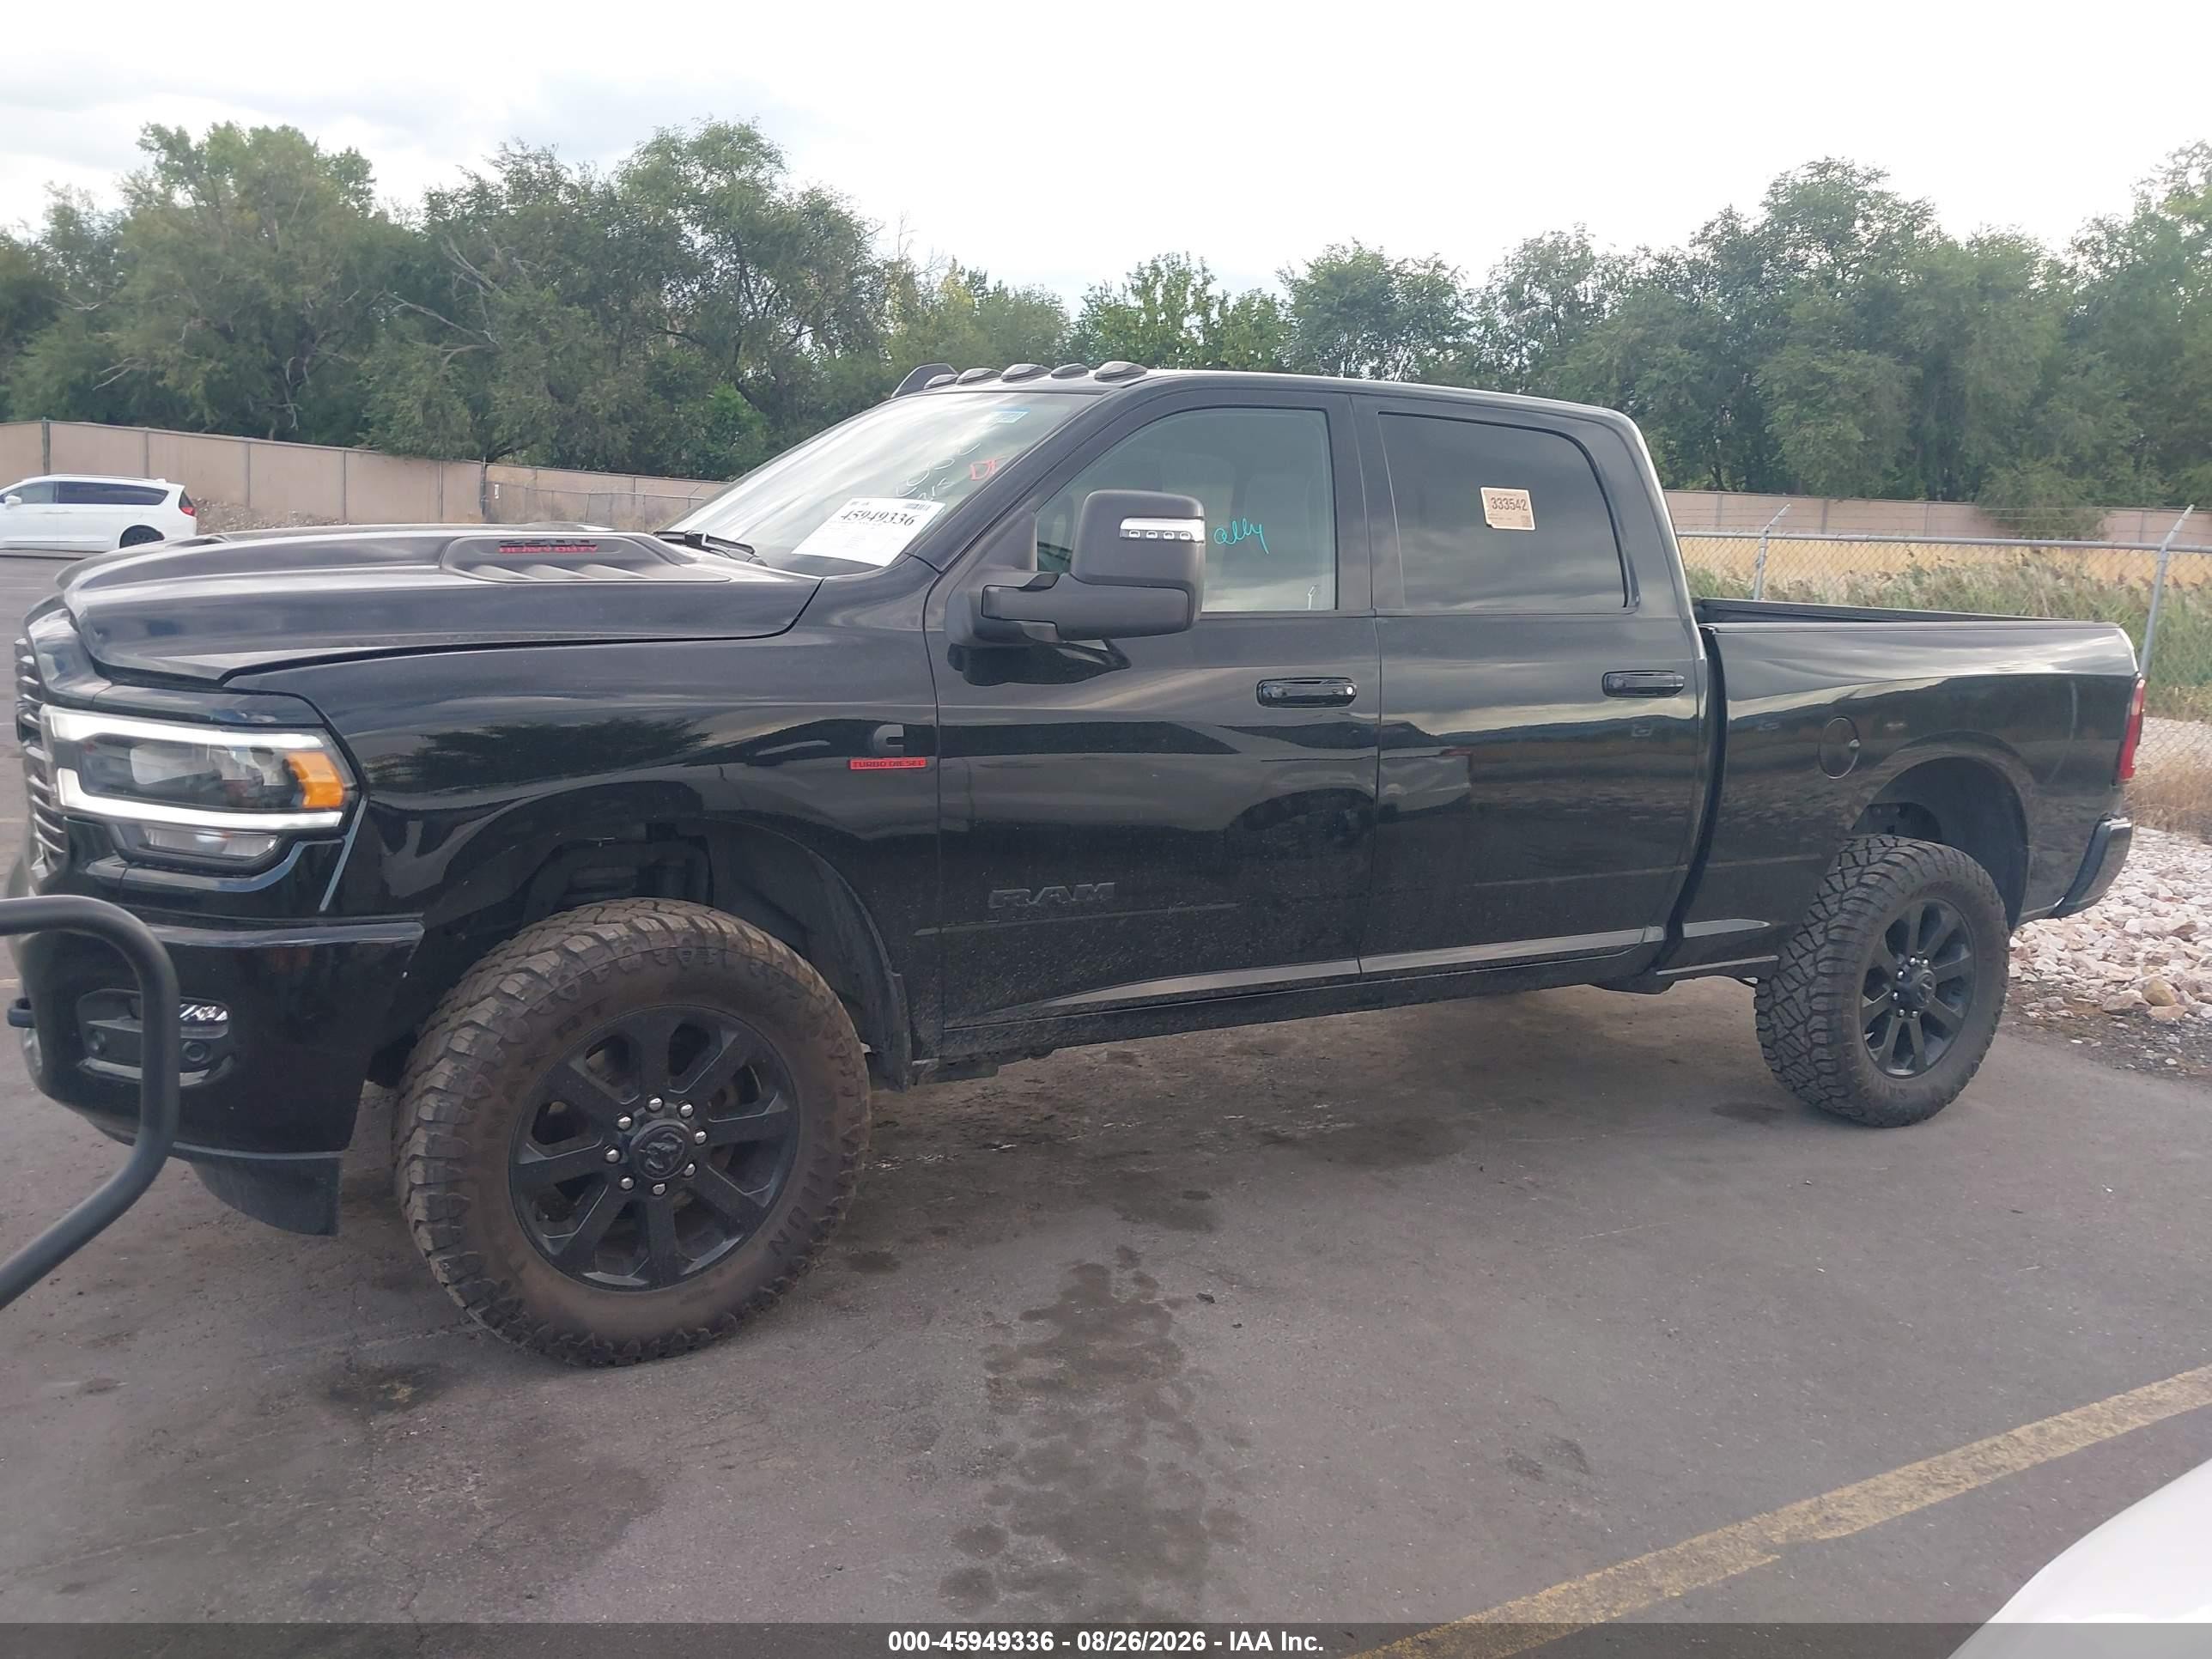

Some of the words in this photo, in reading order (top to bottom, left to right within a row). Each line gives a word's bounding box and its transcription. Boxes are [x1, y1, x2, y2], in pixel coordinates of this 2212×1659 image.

[1490, 496, 1528, 512] 333542
[840, 508, 921, 526] 45949336
[1213, 517, 1270, 555] ally
[852, 759, 887, 769] TURBO
[888, 758, 925, 768] DIESEL
[989, 882, 1115, 908] RAM
